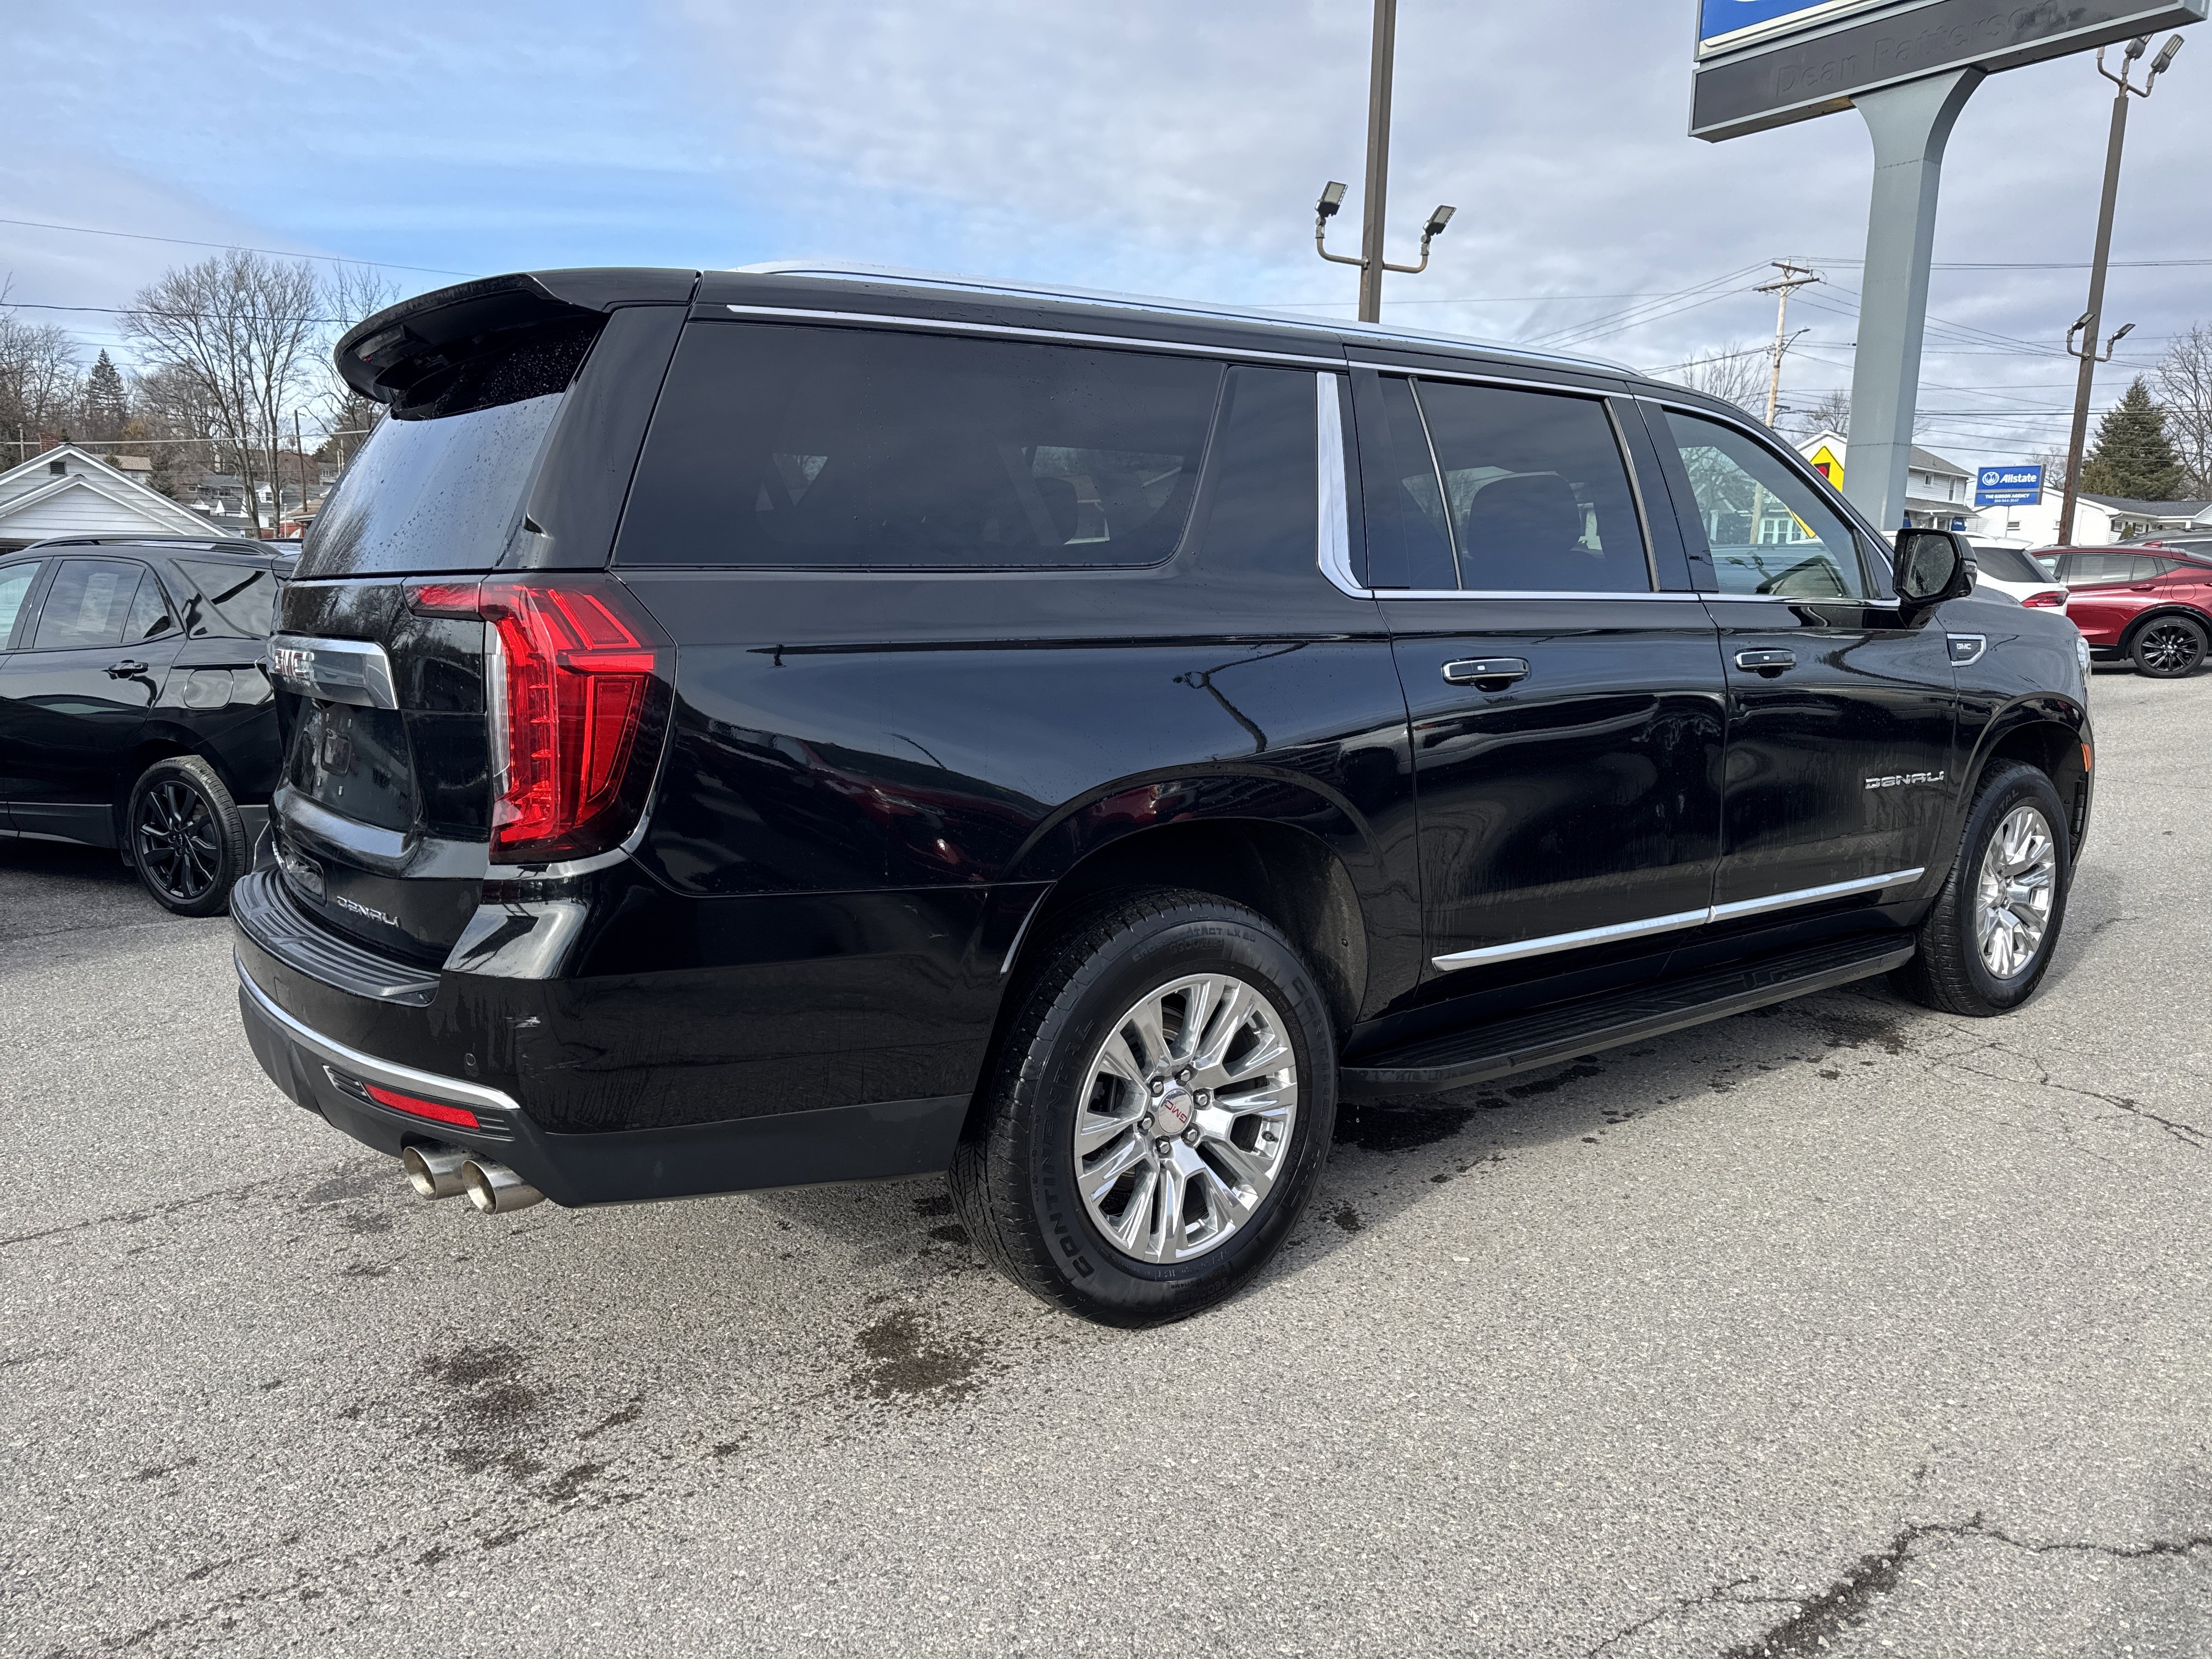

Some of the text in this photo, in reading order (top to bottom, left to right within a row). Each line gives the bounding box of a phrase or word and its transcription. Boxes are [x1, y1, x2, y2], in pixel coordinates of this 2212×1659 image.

[2000, 473, 2037, 483] Allstate
[1865, 770, 1944, 789] DENALI
[336, 896, 400, 928] DENALI
[1164, 1099, 1188, 1124] GMC
[1044, 1018, 1095, 1278] CONTINENTAL
